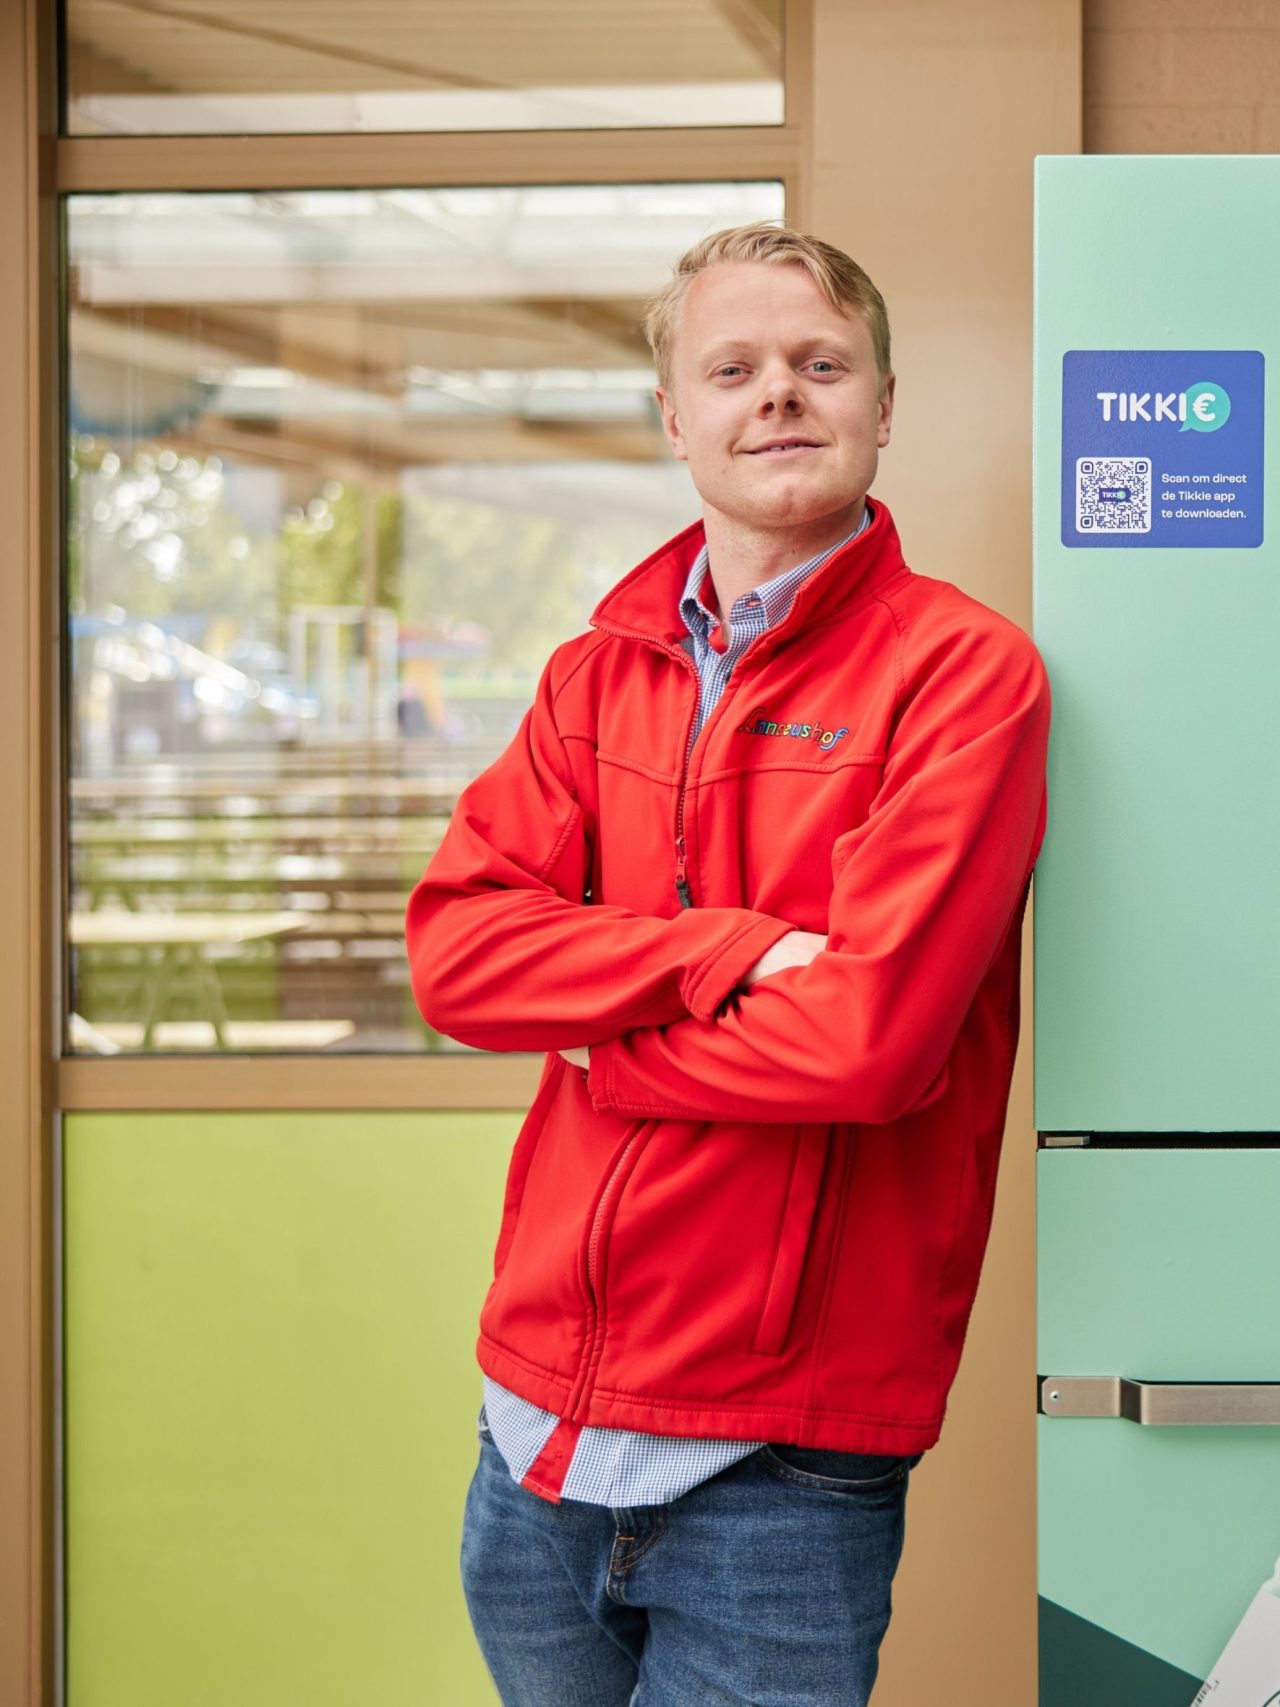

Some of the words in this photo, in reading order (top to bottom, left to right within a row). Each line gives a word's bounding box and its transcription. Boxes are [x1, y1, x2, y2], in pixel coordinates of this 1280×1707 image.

[1161, 473, 1190, 484] Scan
[1192, 475, 1210, 484] om
[1212, 473, 1247, 484] direct
[1161, 491, 1176, 501] de
[1178, 491, 1212, 501] Tikkie
[1214, 493, 1236, 503] app
[1161, 509, 1173, 518] te
[1175, 508, 1247, 519] downloaden.
